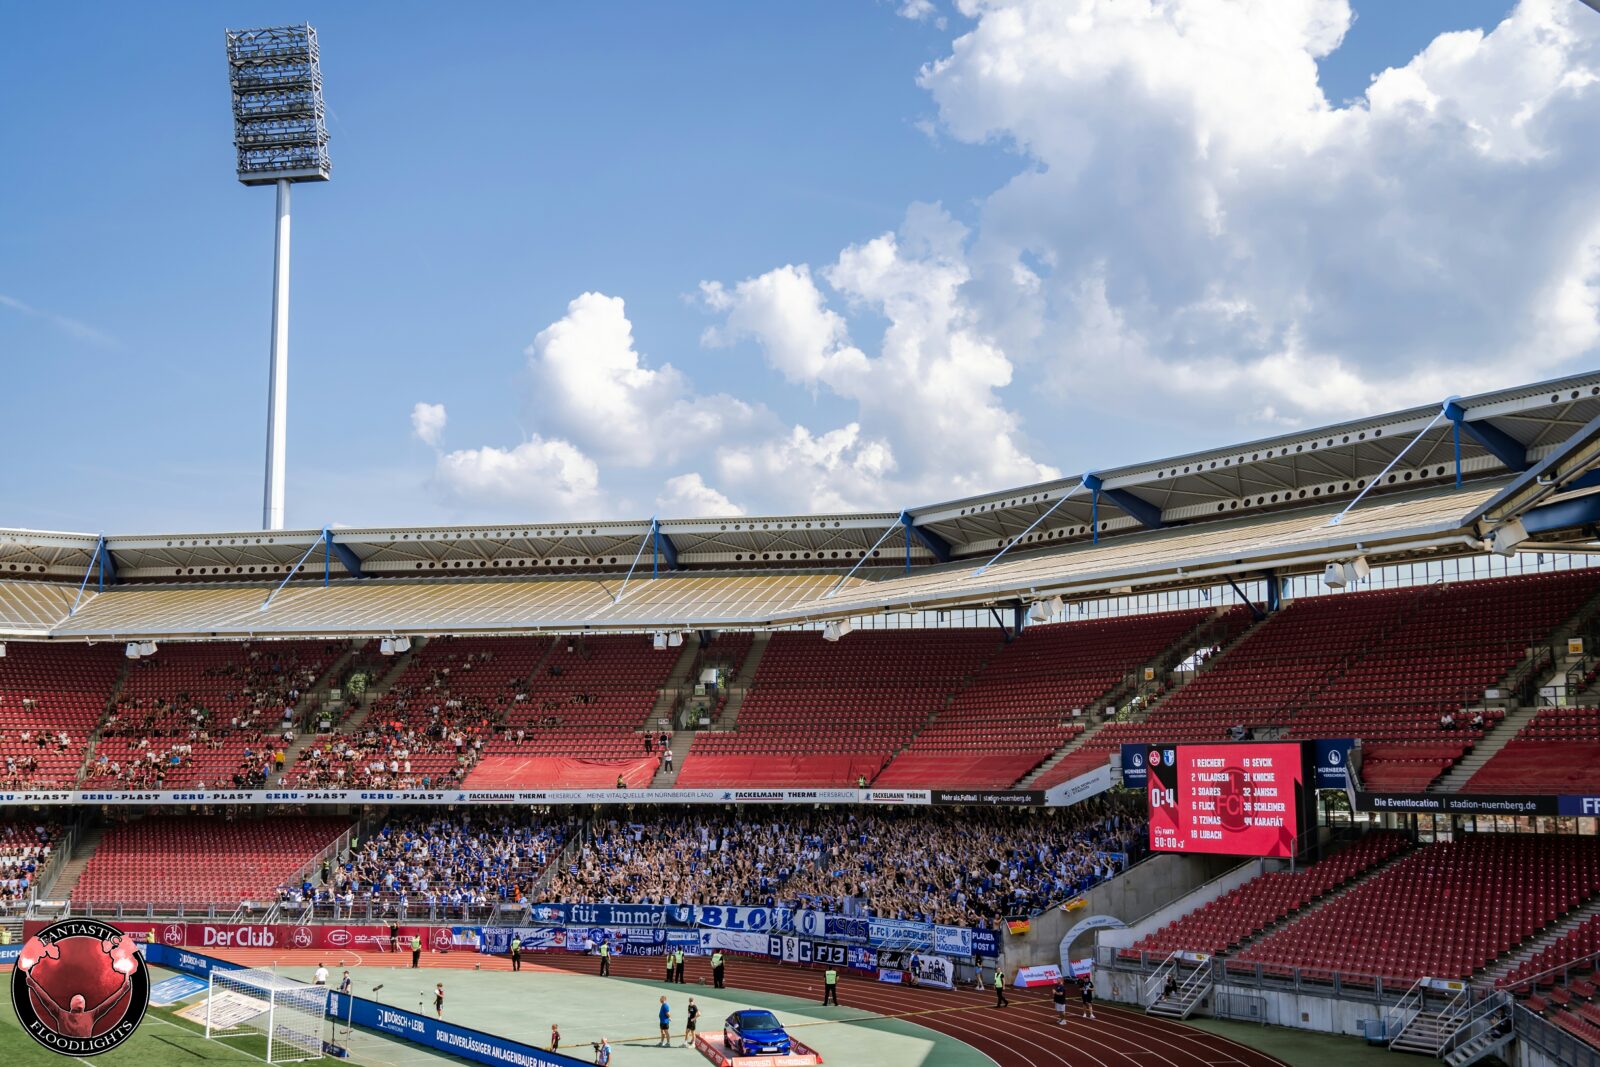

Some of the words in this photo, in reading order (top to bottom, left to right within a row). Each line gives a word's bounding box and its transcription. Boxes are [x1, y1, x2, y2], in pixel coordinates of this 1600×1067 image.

[1192, 759, 1195, 767] 1
[1197, 758, 1225, 767] REICHERT
[1243, 758, 1250, 767] 19
[1191, 773, 1195, 781] 2
[1243, 773, 1250, 781] 31
[1253, 773, 1275, 781] KNOCHE
[1198, 788, 1221, 796] SOARES
[1243, 788, 1251, 796] 32
[1254, 788, 1278, 797] JANISCH
[1152, 788, 1174, 808] 0:4
[1192, 802, 1196, 810] 6
[1199, 802, 1215, 810] FLICK
[1243, 802, 1251, 811] 36
[1254, 803, 1285, 811] SCHLEIMER
[1374, 798, 1386, 806] Die
[1388, 798, 1439, 807] Eventlocation
[1450, 800, 1536, 811] stadion-nuernberg.de
[1192, 816, 1197, 824] 9
[1199, 816, 1221, 825] TZIMAS
[1200, 830, 1222, 839] LUBACH
[1155, 837, 1176, 847] 90:00
[571, 904, 599, 922] für
[203, 926, 234, 946] Der
[236, 926, 274, 946] Club
[387, 1011, 407, 1027] DÖRSCH
[436, 1029, 448, 1043] DEIN
[449, 1033, 491, 1054] ZUVERLÄSSIGER
[491, 1045, 537, 1067] ANLAGENBAUER
